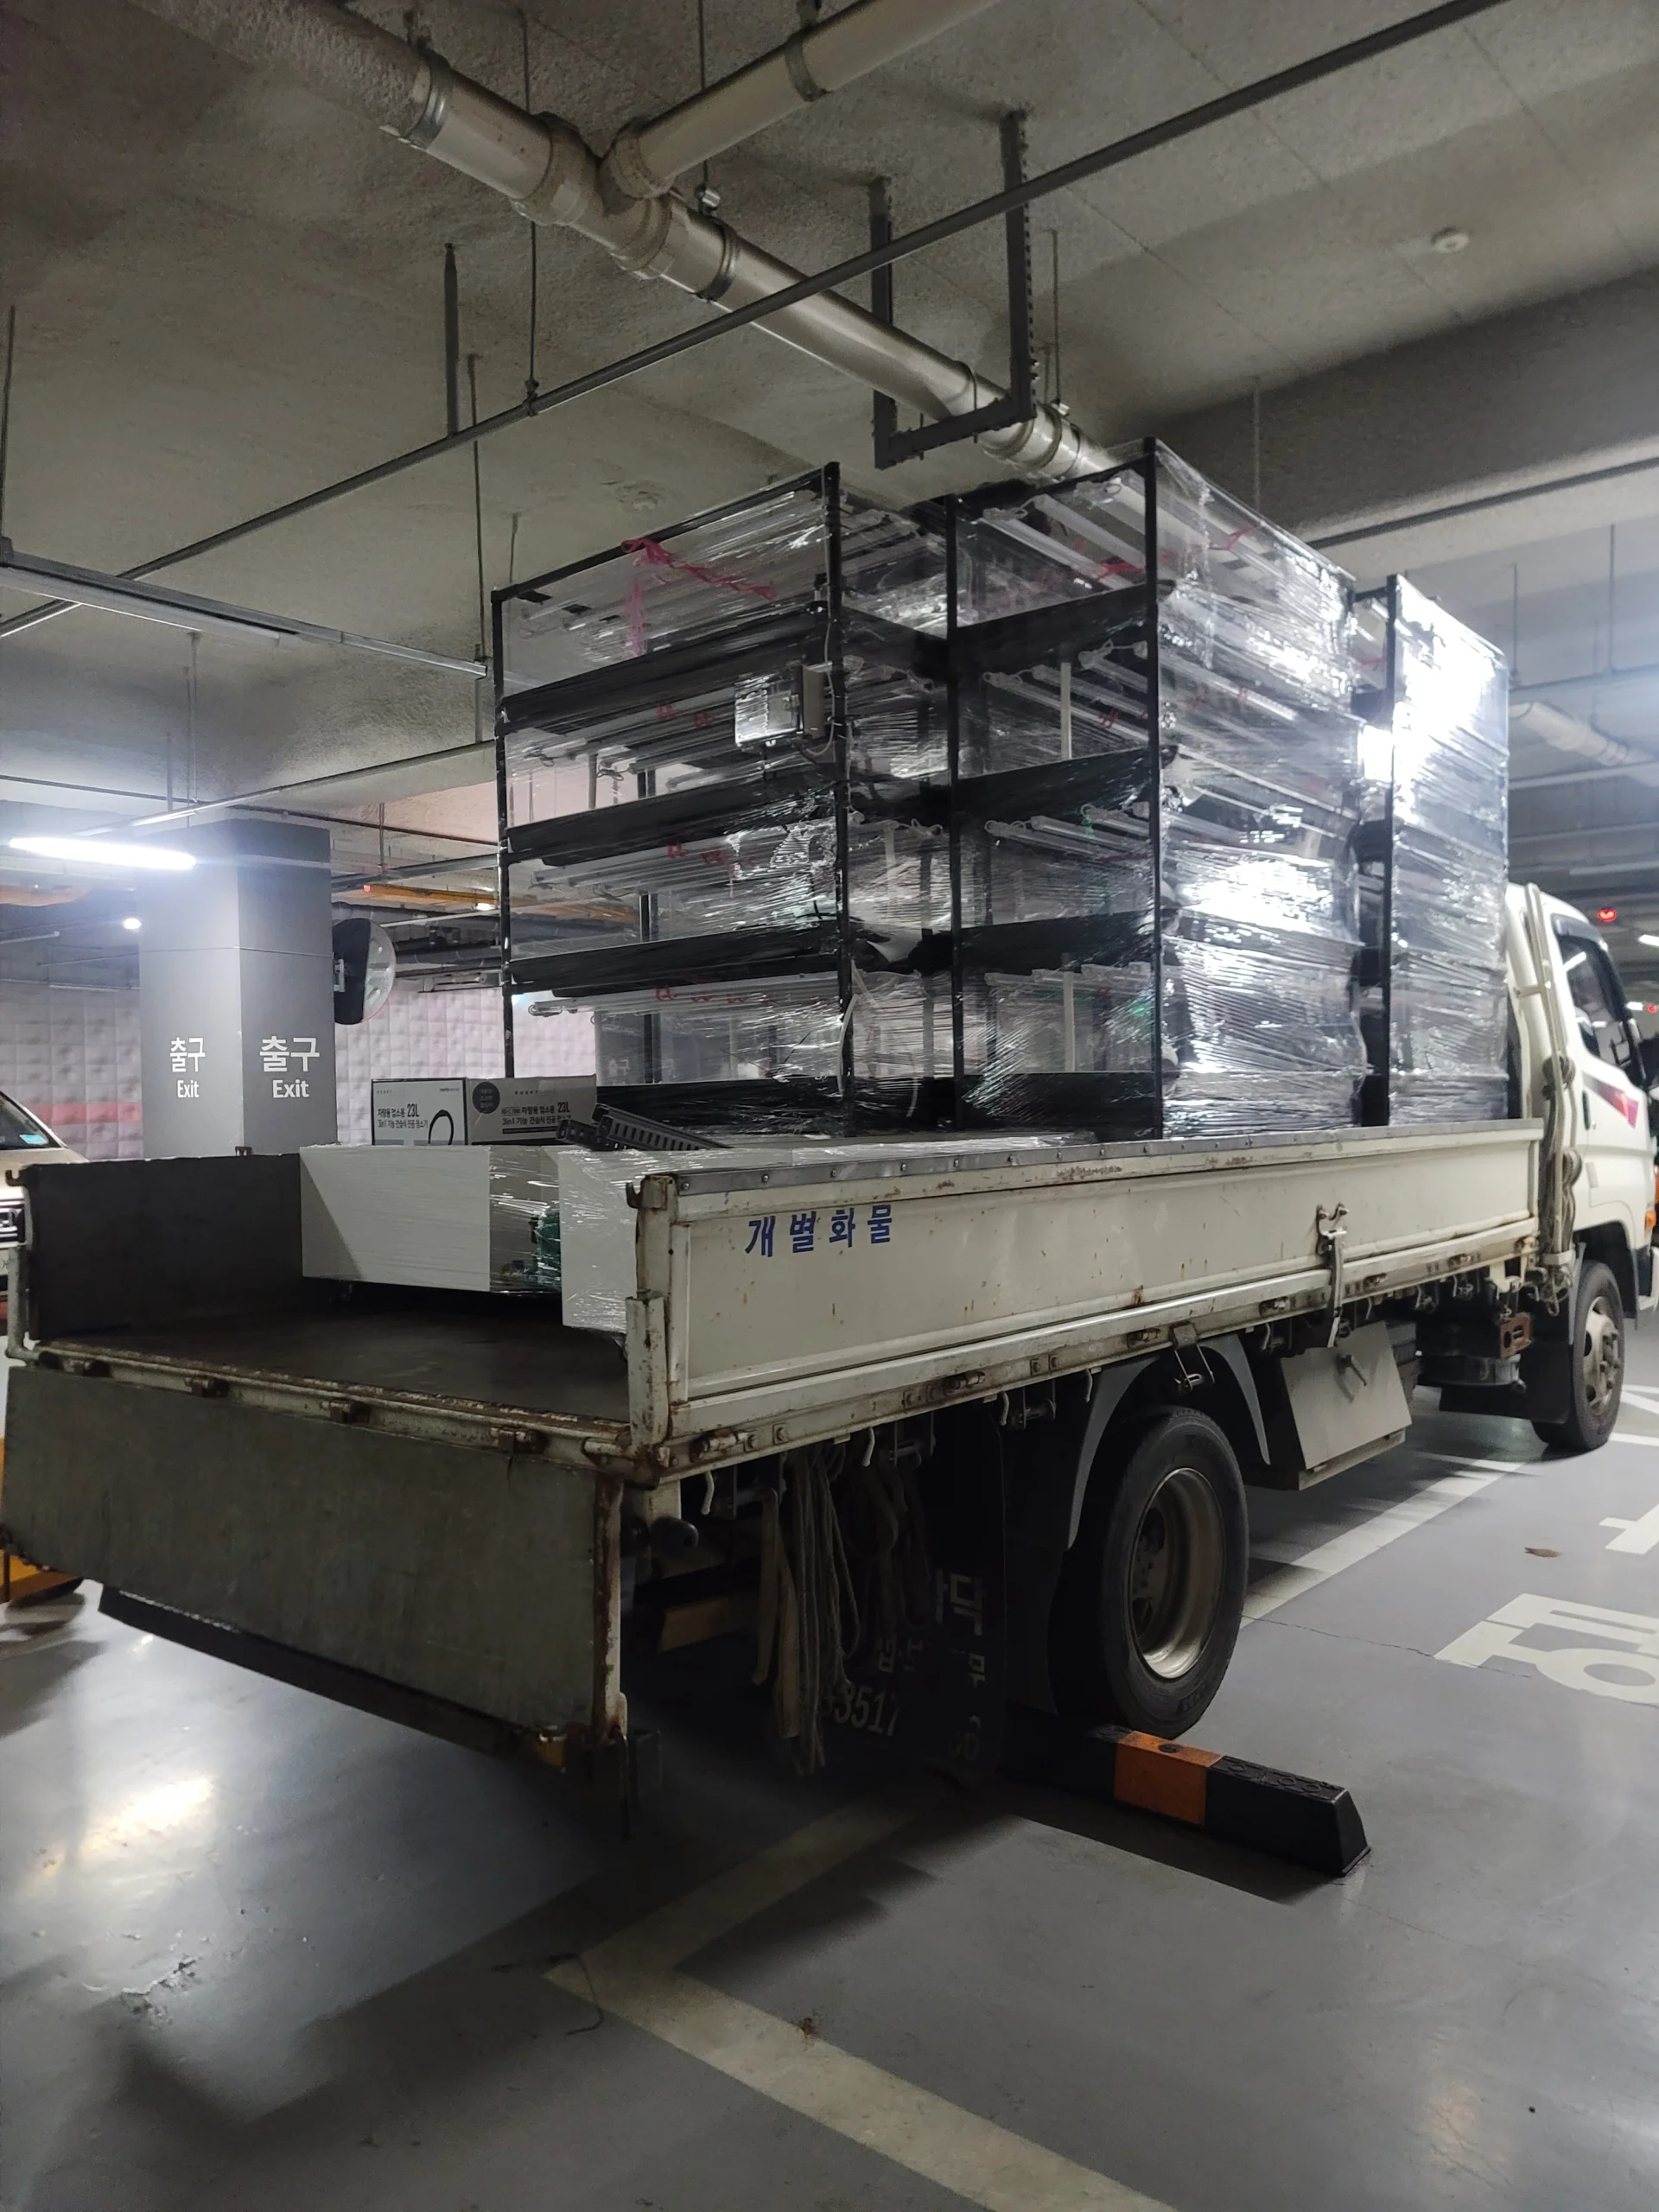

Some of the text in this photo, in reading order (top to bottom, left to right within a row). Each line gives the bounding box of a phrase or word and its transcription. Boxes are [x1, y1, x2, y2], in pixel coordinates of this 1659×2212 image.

[170, 1037, 206, 1072] 출구
[259, 1035, 321, 1072] 출구
[177, 1079, 200, 1098] Exit
[272, 1078, 309, 1098] Exit
[407, 1103, 420, 1117] 23L
[557, 1101, 570, 1113] 23L
